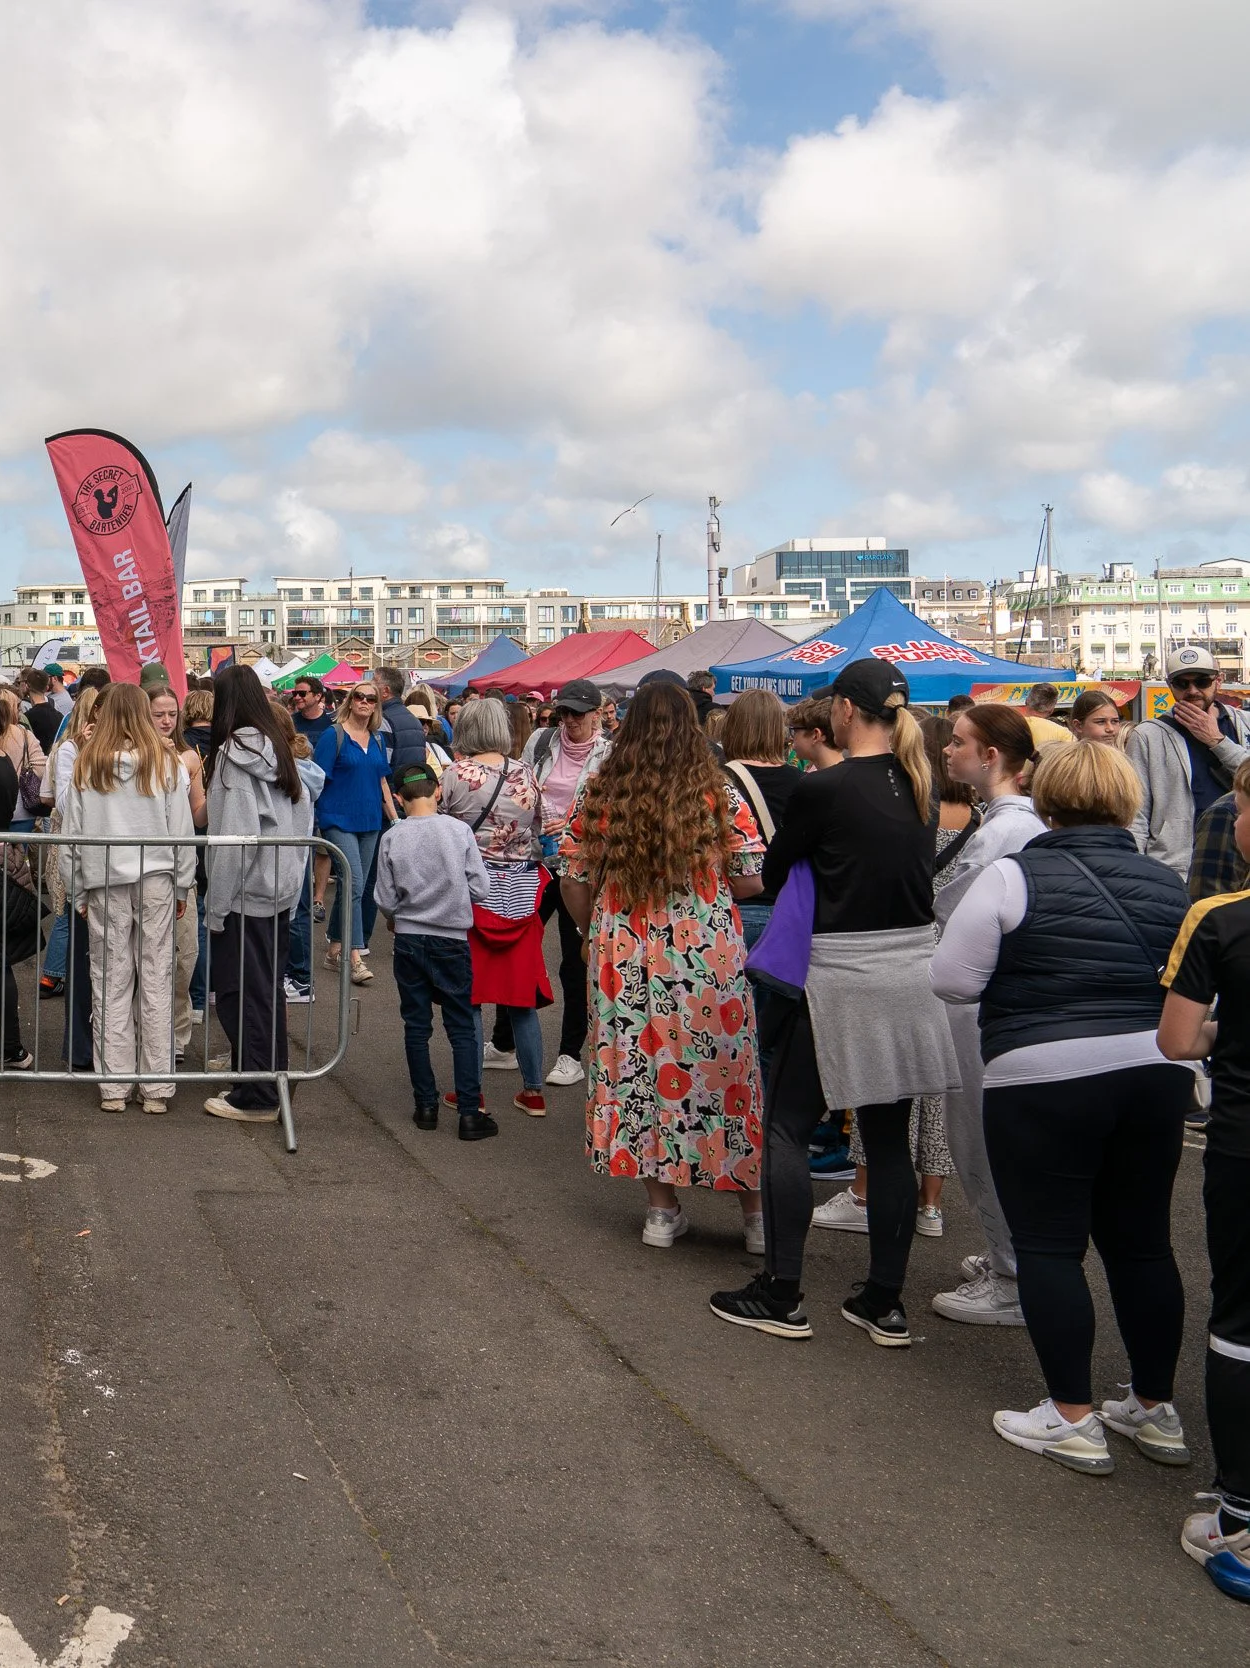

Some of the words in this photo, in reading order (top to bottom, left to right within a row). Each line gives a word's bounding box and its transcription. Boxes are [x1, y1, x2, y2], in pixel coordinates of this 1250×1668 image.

[80, 479, 95, 497] THE
[93, 469, 124, 484] SECRET
[121, 483, 135, 495] 2021
[89, 504, 133, 533] BARTENDER
[113, 548, 143, 600] BAR
[871, 640, 973, 658] SLUSH
[731, 675, 742, 691] GET
[743, 676, 759, 690] YOUR
[777, 679, 787, 696] ON
[787, 679, 802, 696] ONE!
